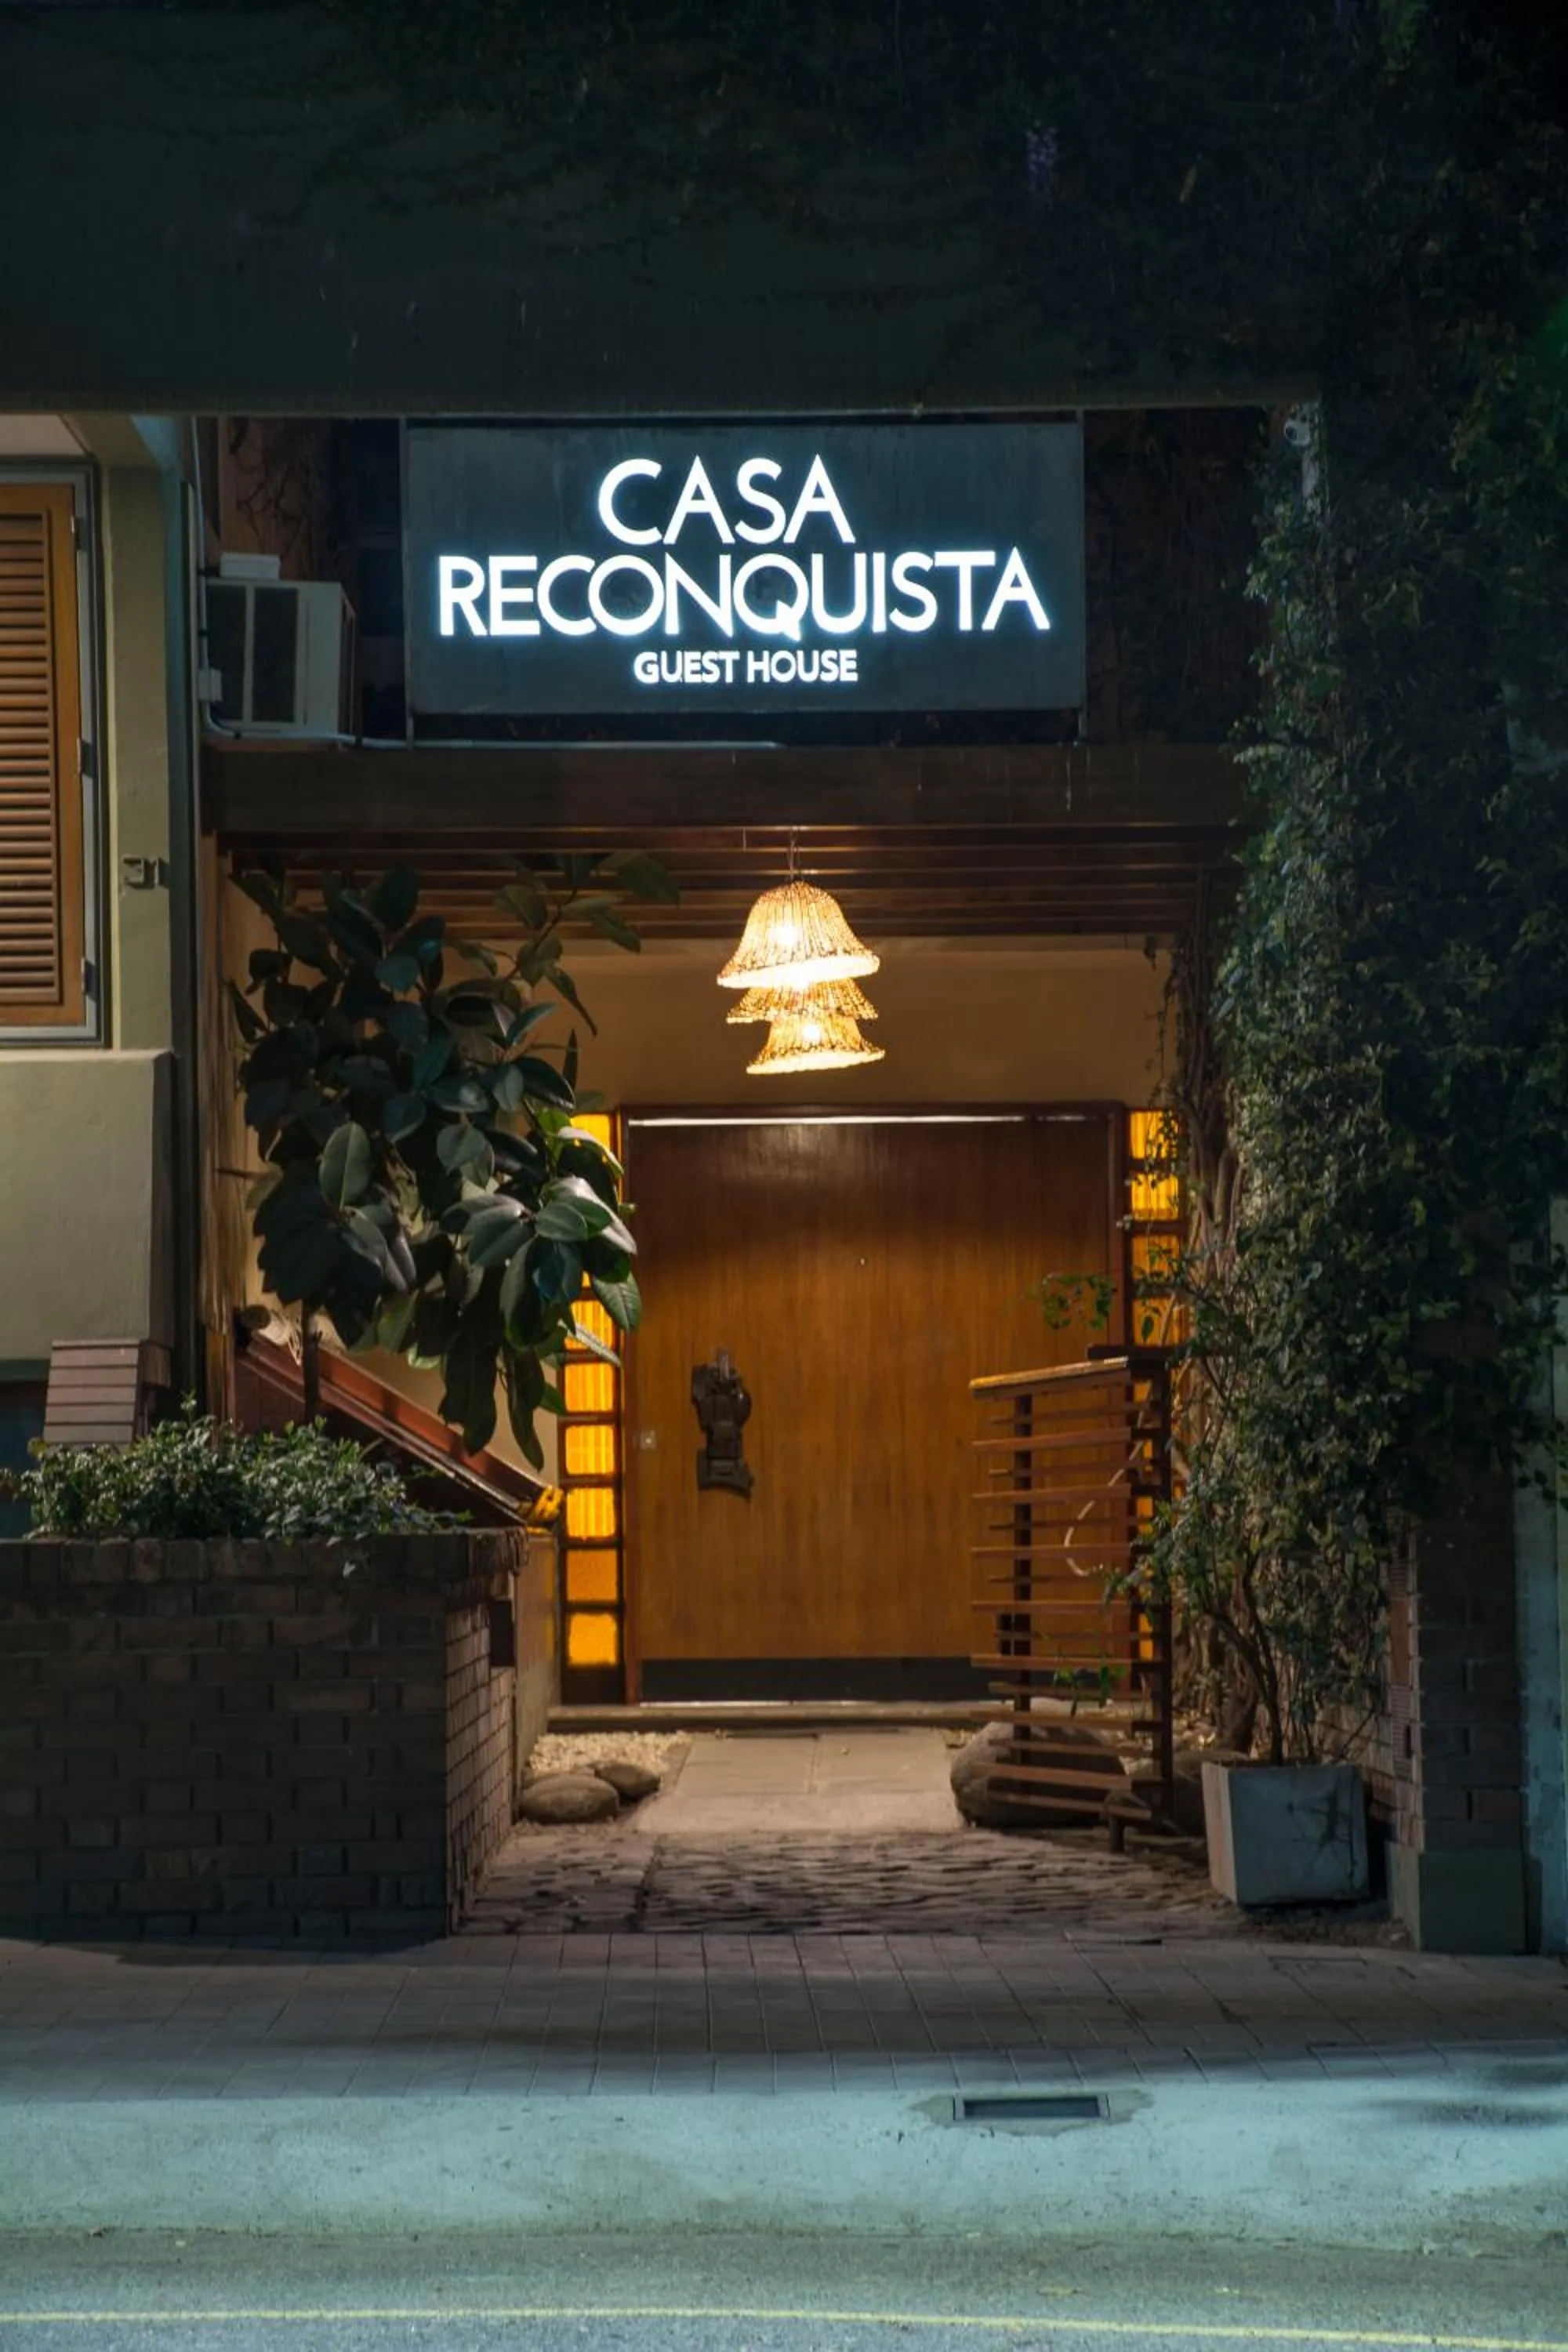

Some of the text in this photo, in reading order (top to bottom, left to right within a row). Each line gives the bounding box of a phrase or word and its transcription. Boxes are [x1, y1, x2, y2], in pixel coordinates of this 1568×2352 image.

[597, 455, 856, 546] CASA
[438, 547, 1051, 642] RECONQUISTA
[633, 650, 858, 684] GUEST HOUSE
